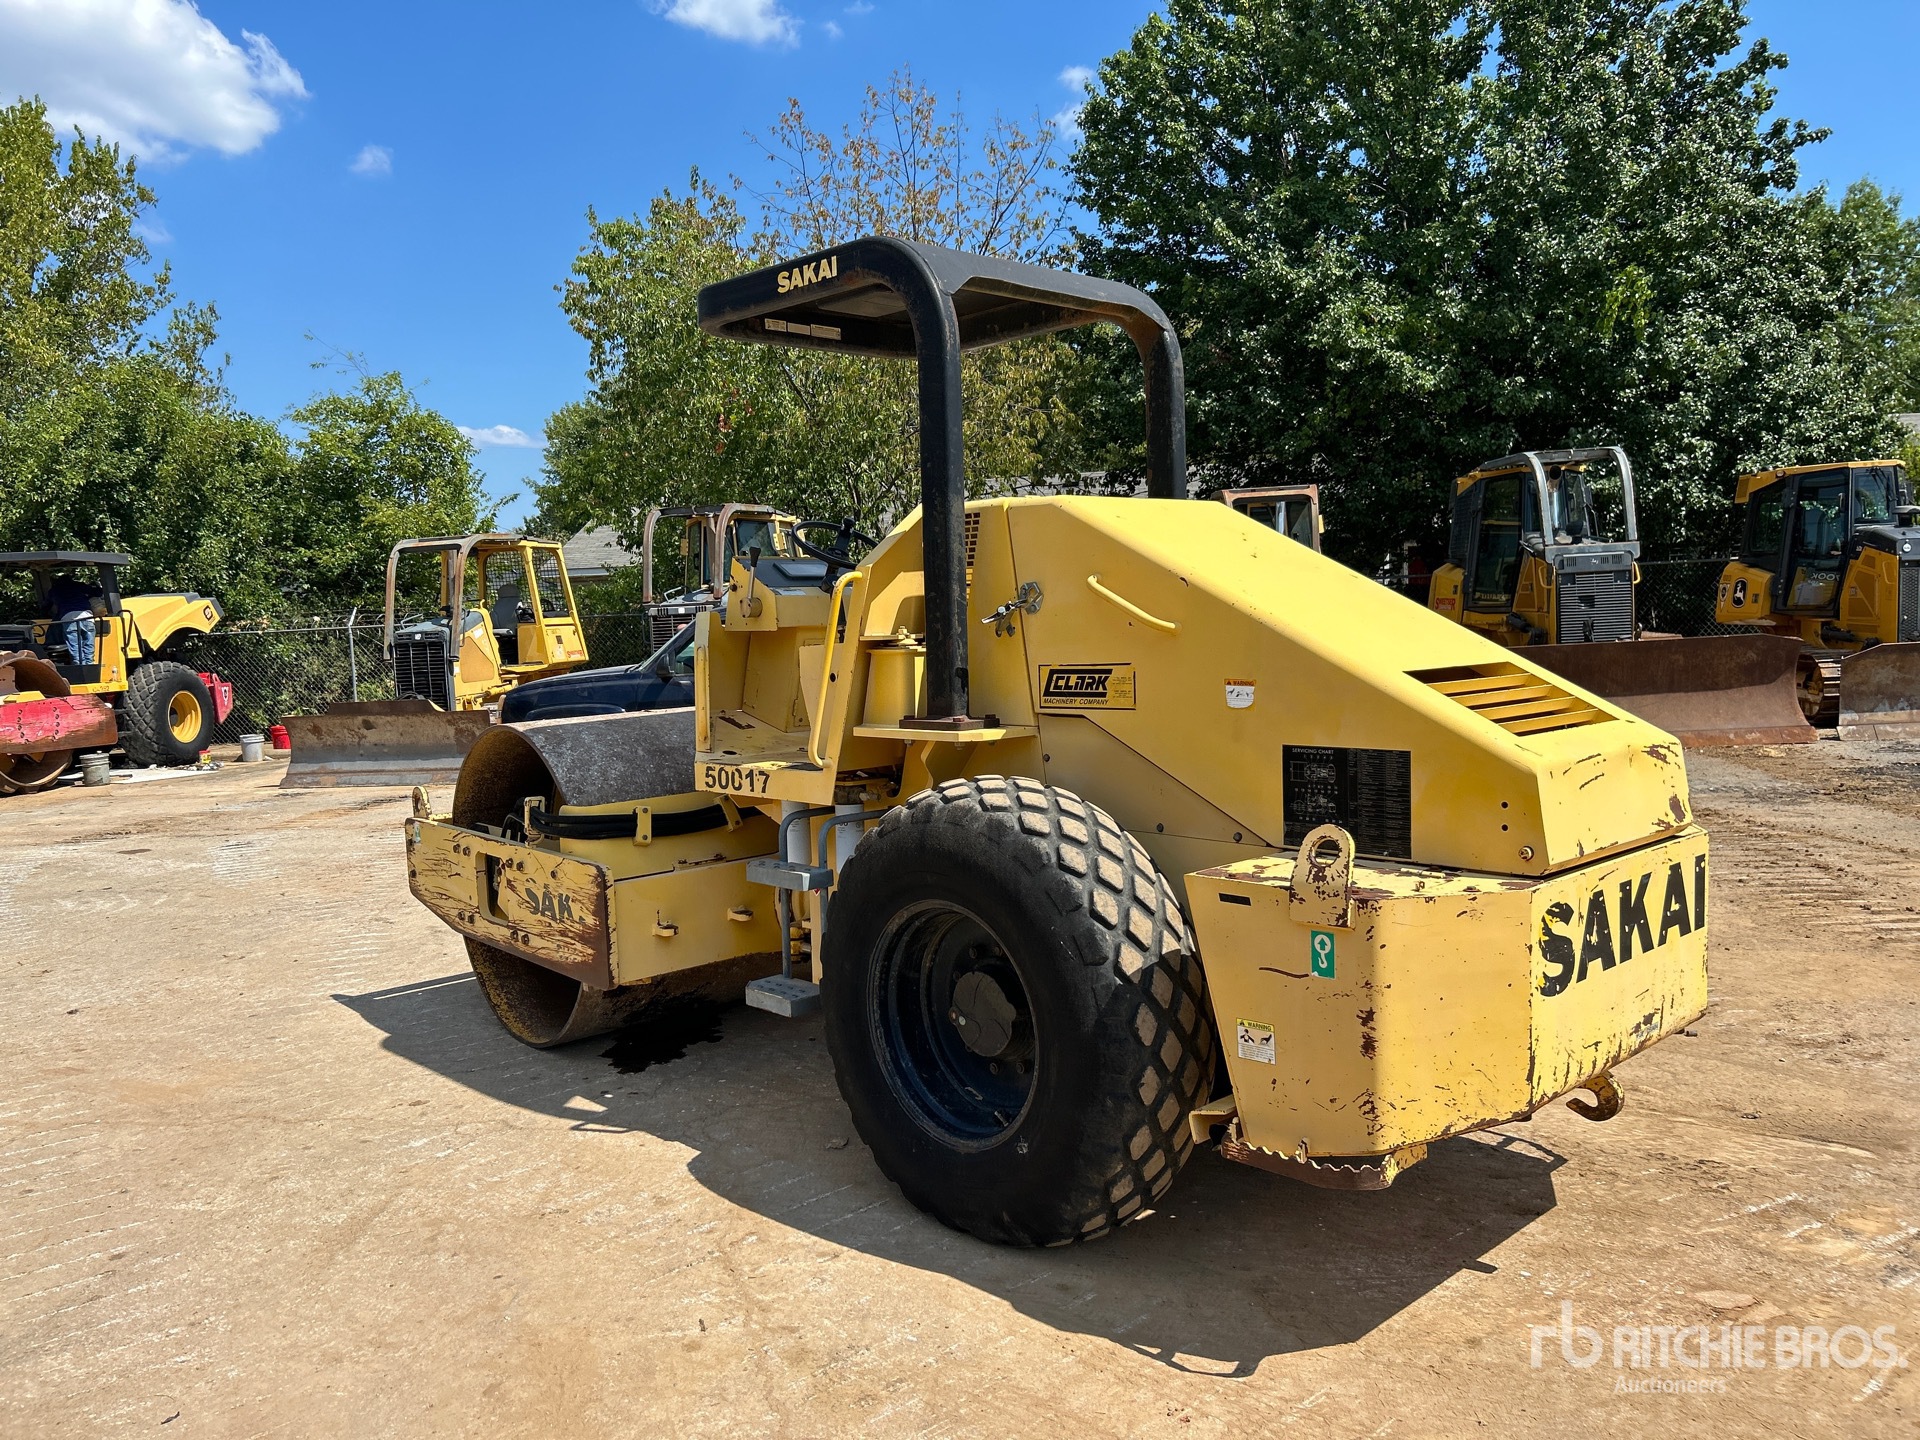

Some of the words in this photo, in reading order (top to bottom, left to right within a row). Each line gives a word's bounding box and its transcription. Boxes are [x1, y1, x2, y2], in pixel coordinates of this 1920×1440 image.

[777, 255, 838, 293] SAKAI
[1043, 697, 1077, 705] MACHINERY
[1079, 698, 1110, 706] COMPANY
[704, 765, 771, 794] 50017
[1537, 853, 1707, 998] SAKAI
[1247, 1021, 1272, 1031] WARNING
